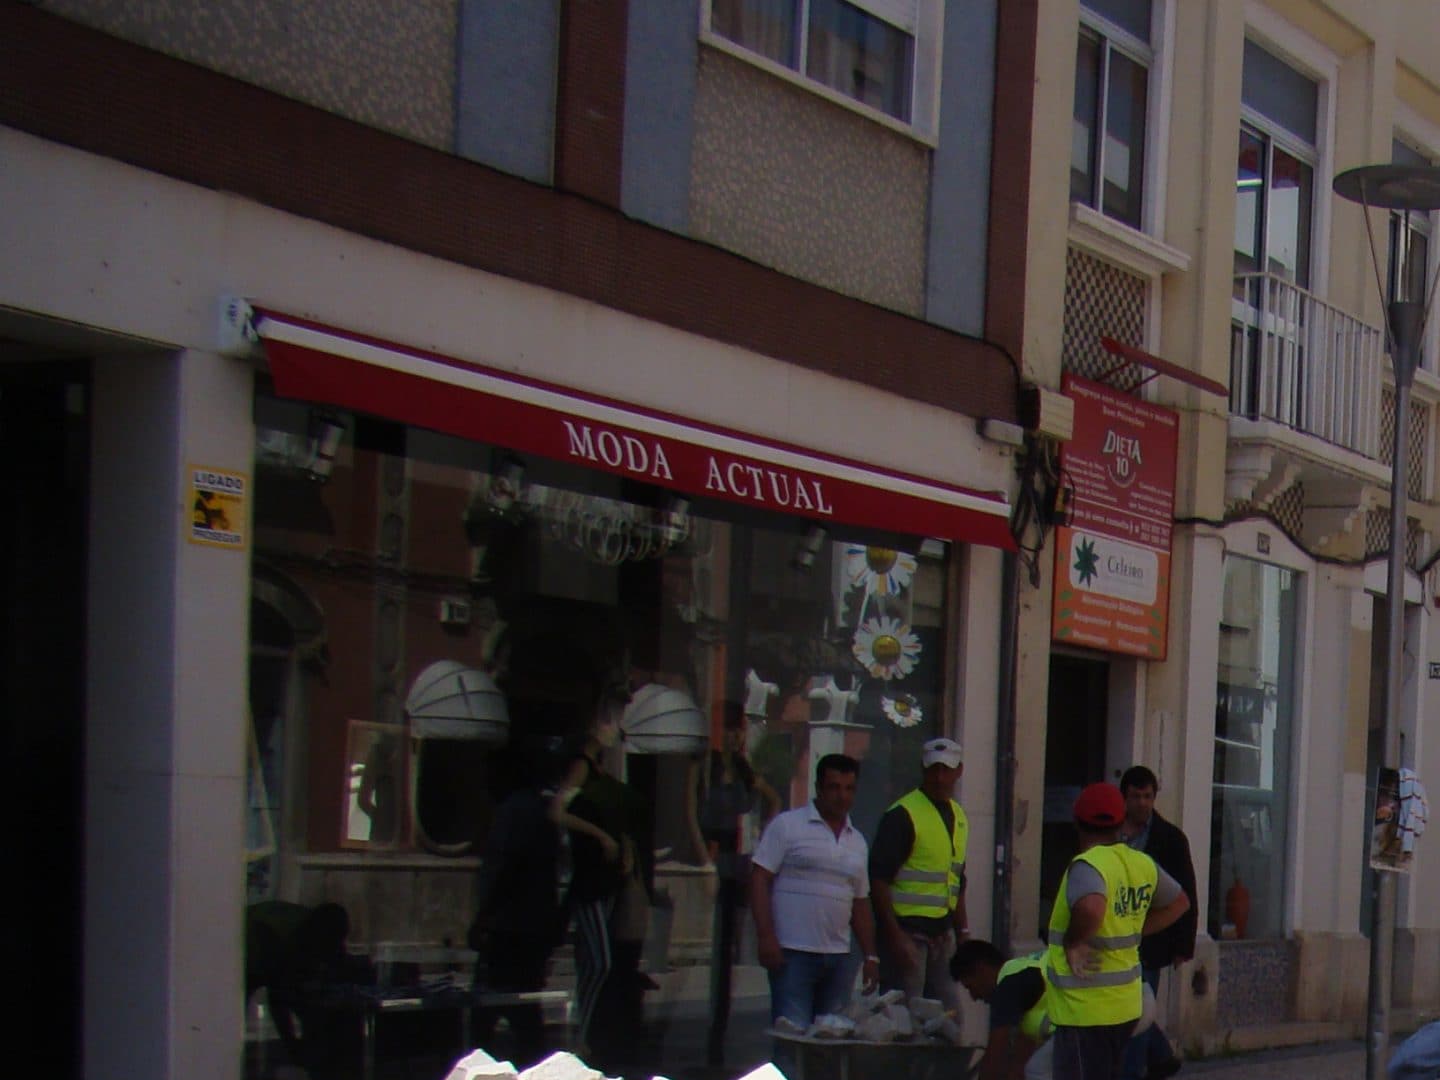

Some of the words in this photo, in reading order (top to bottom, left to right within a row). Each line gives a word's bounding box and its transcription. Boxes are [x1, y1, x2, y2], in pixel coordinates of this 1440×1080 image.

[1102, 430, 1142, 464] DIETA
[563, 420, 673, 481] MODA
[705, 456, 833, 515] ACTUAL
[1116, 457, 1128, 476] 10
[194, 471, 243, 489] LIGADO
